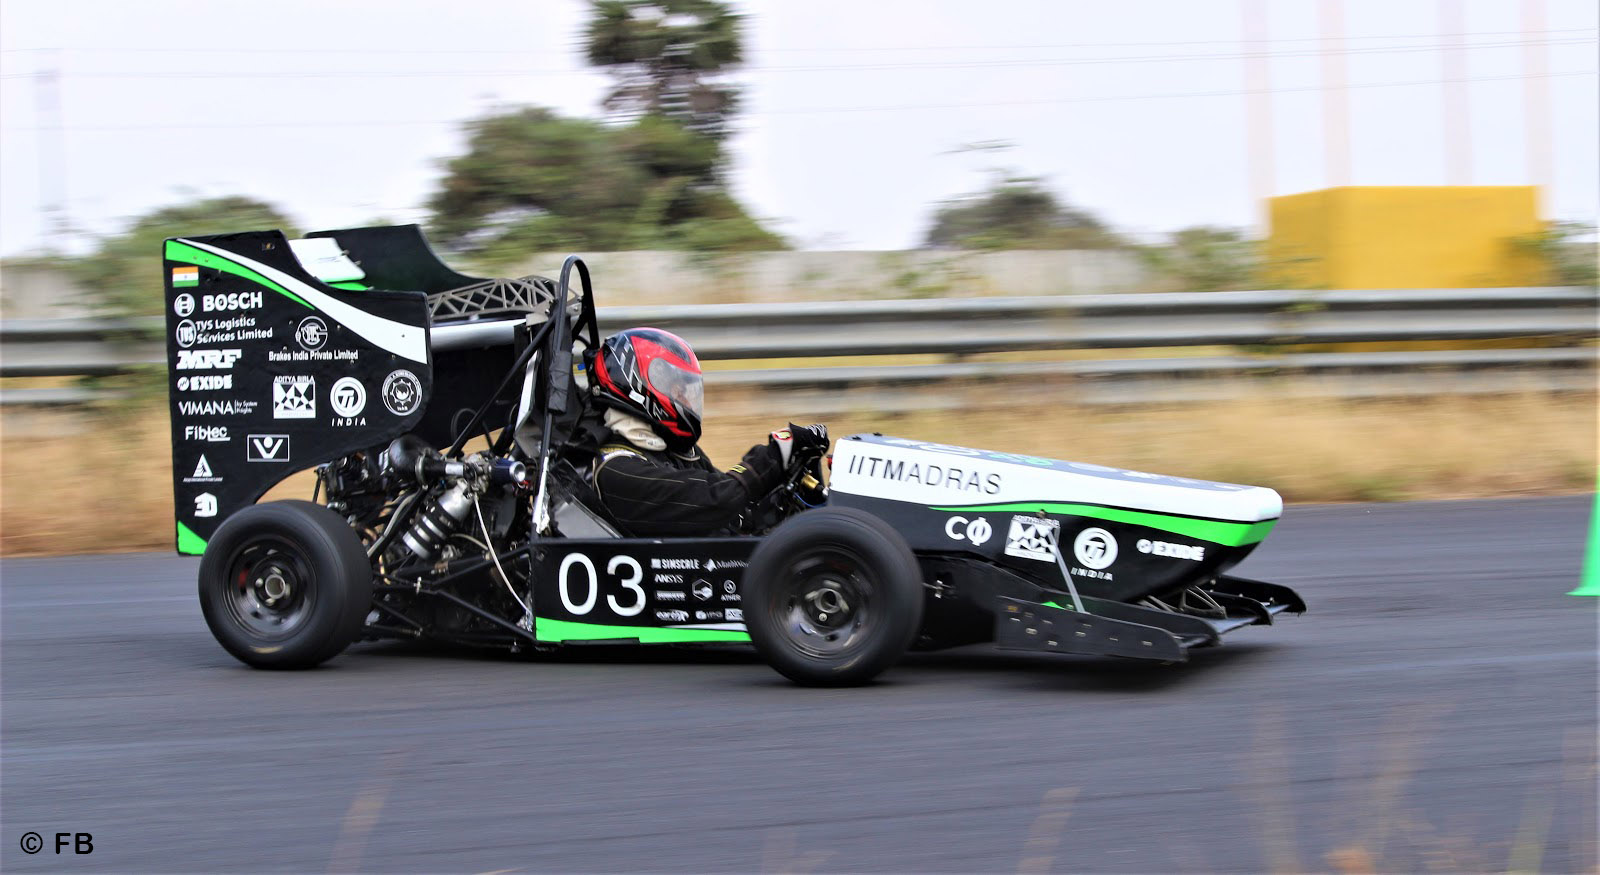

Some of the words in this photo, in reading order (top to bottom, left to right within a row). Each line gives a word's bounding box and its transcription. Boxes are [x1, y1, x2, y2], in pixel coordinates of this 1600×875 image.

[202, 291, 263, 312] BOSCH
[195, 319, 214, 333] TVS
[215, 317, 256, 331] Logistics
[196, 332, 235, 345] Services
[237, 327, 273, 341] Limited
[176, 349, 241, 369] MRF
[268, 351, 292, 362] Brakes
[292, 351, 309, 361] India
[309, 349, 333, 361] Private
[333, 349, 359, 361] Limited
[189, 374, 233, 391] EXIDE
[273, 375, 296, 383] ADITYA
[296, 375, 315, 383] BIRLA
[178, 400, 234, 416] VIMANA
[331, 417, 367, 427] INDIA
[654, 573, 684, 584] ANSYS
[1070, 566, 1114, 581] INDIA
[558, 552, 646, 617] 03
